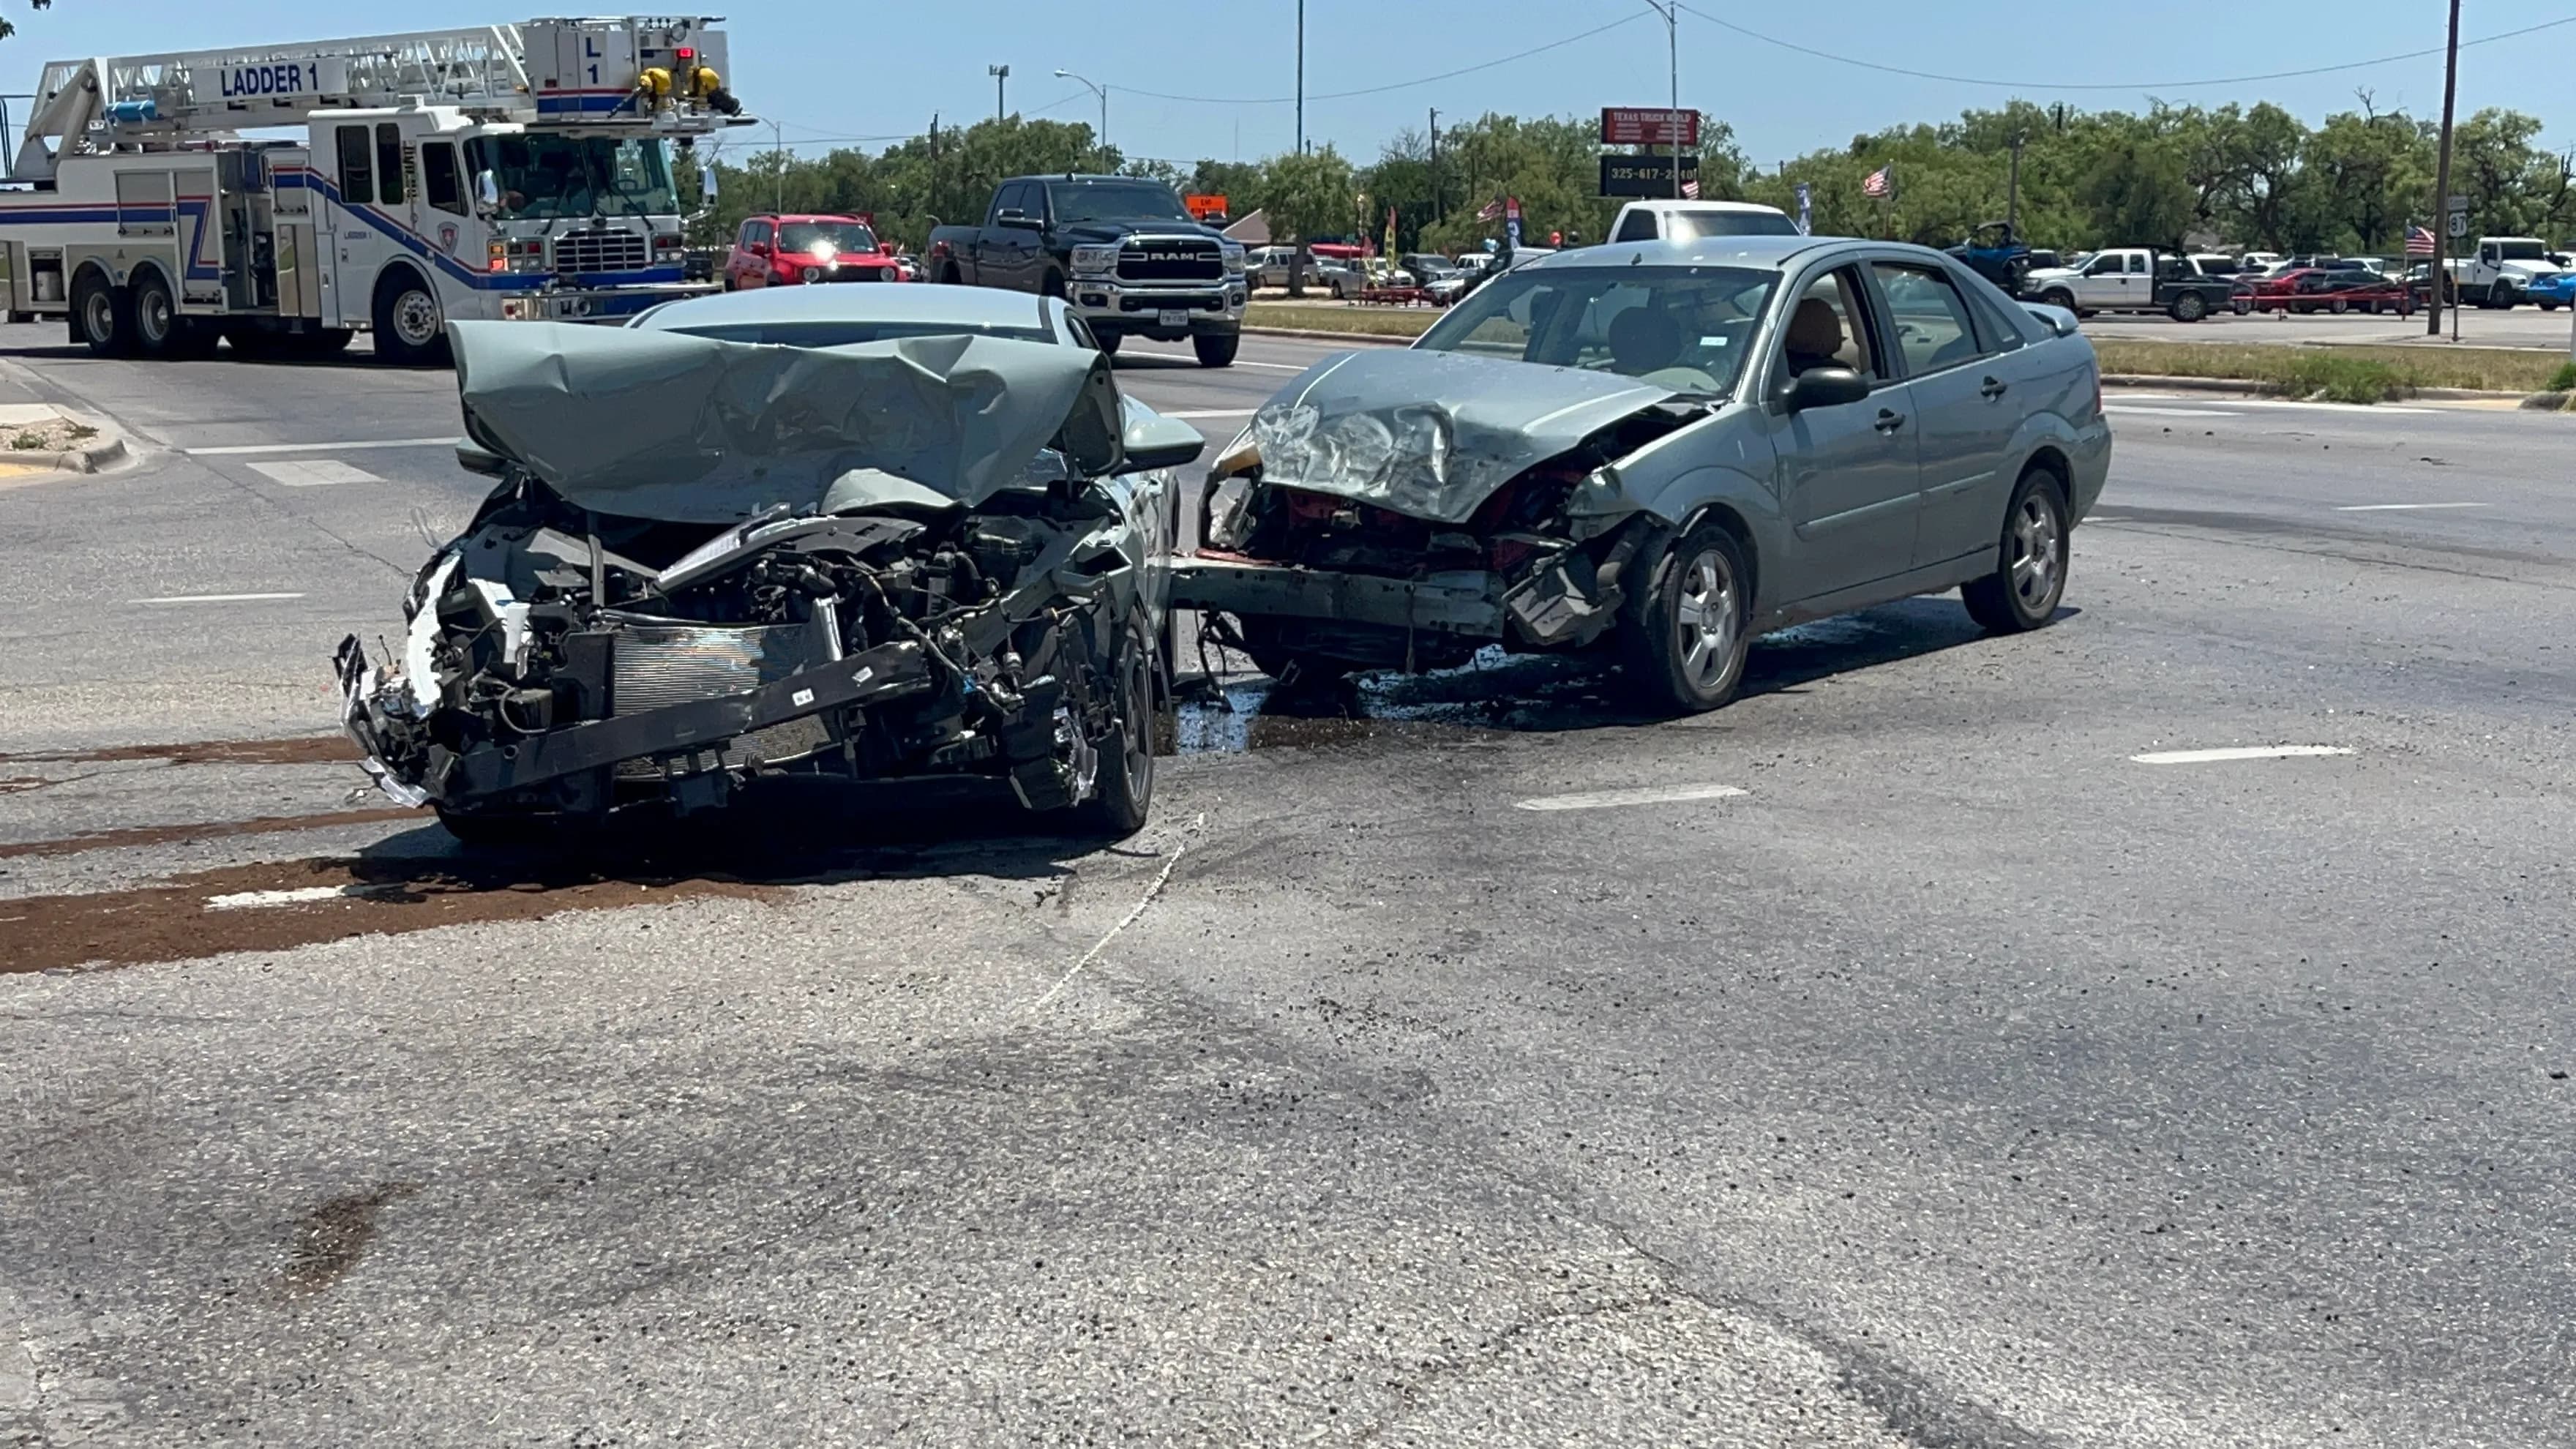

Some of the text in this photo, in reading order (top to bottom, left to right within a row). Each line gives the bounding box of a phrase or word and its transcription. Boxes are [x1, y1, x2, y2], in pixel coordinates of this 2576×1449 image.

[585, 37, 602, 58] L
[220, 62, 318, 97] LADDER 1
[587, 64, 599, 84] 1
[1613, 112, 1691, 123] TEXAS TRUCK WRLD
[1611, 167, 1693, 180] 325-617-240
[1150, 252, 1195, 261] RAM
